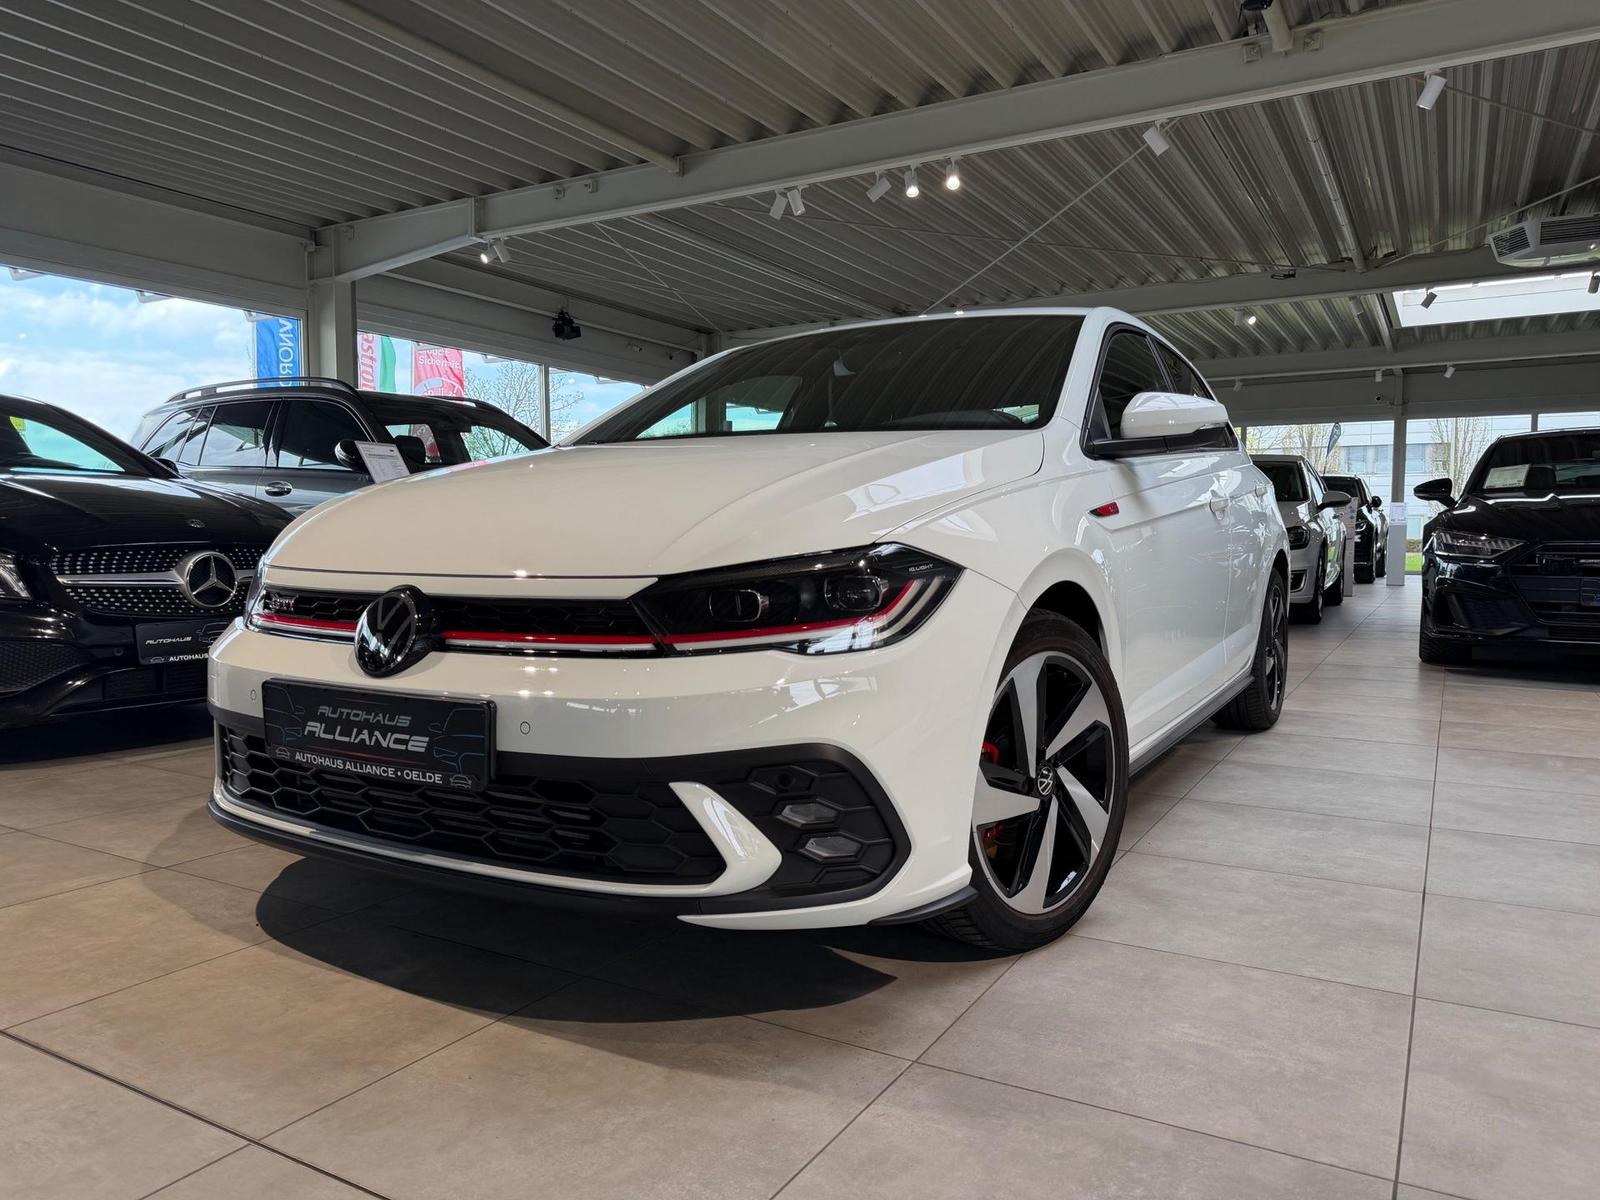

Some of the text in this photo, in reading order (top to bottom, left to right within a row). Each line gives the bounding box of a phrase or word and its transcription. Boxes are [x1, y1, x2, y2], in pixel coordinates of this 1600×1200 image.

[360, 334, 377, 391] astrol
[145, 636, 192, 645] AUTOHAUS
[168, 653, 209, 662] AUTOHAUS
[317, 705, 412, 727] AUTOHAUS
[304, 721, 429, 752] ALLIANCE
[294, 752, 443, 784] AUTOHAUS ALLIANCE OELDE
